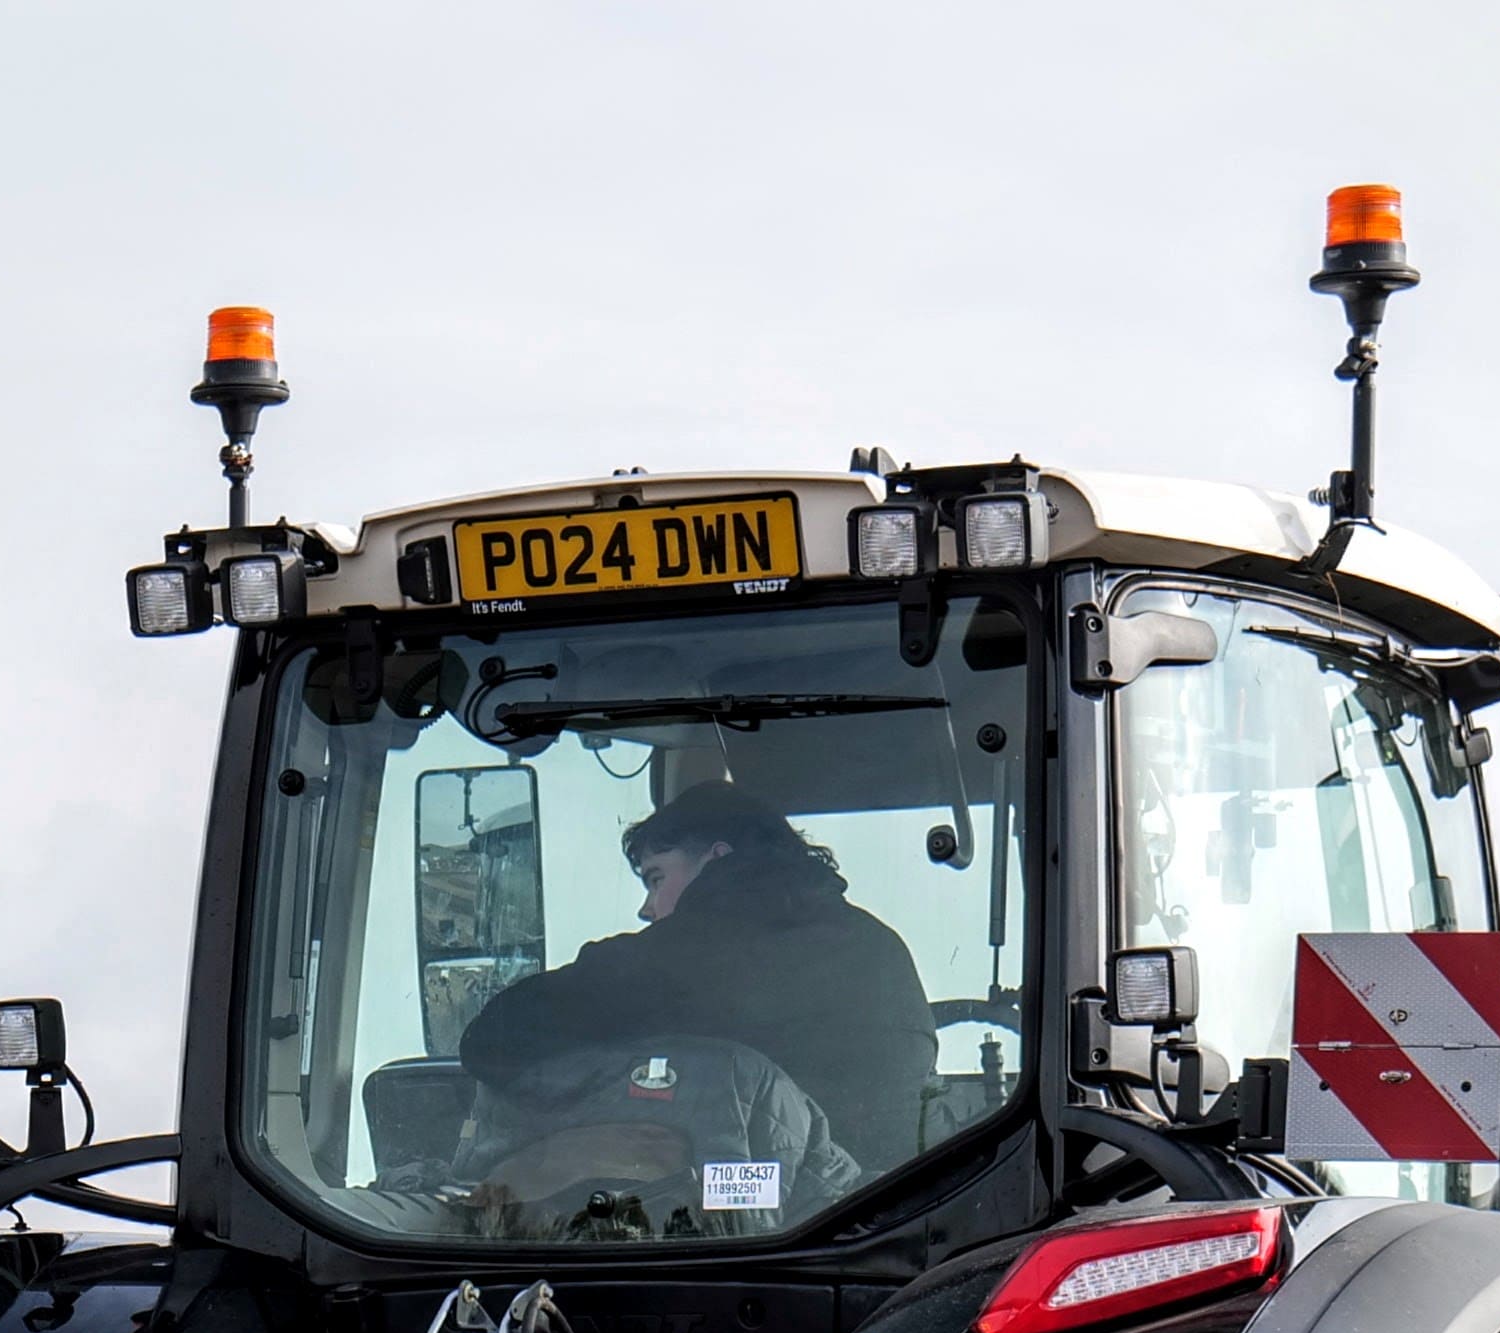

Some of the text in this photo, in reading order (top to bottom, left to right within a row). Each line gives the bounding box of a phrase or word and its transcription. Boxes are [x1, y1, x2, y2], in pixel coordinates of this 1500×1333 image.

[481, 510, 773, 592] PO24 DWN
[733, 578, 790, 595] FENDT
[472, 599, 527, 615] It's Fendt.
